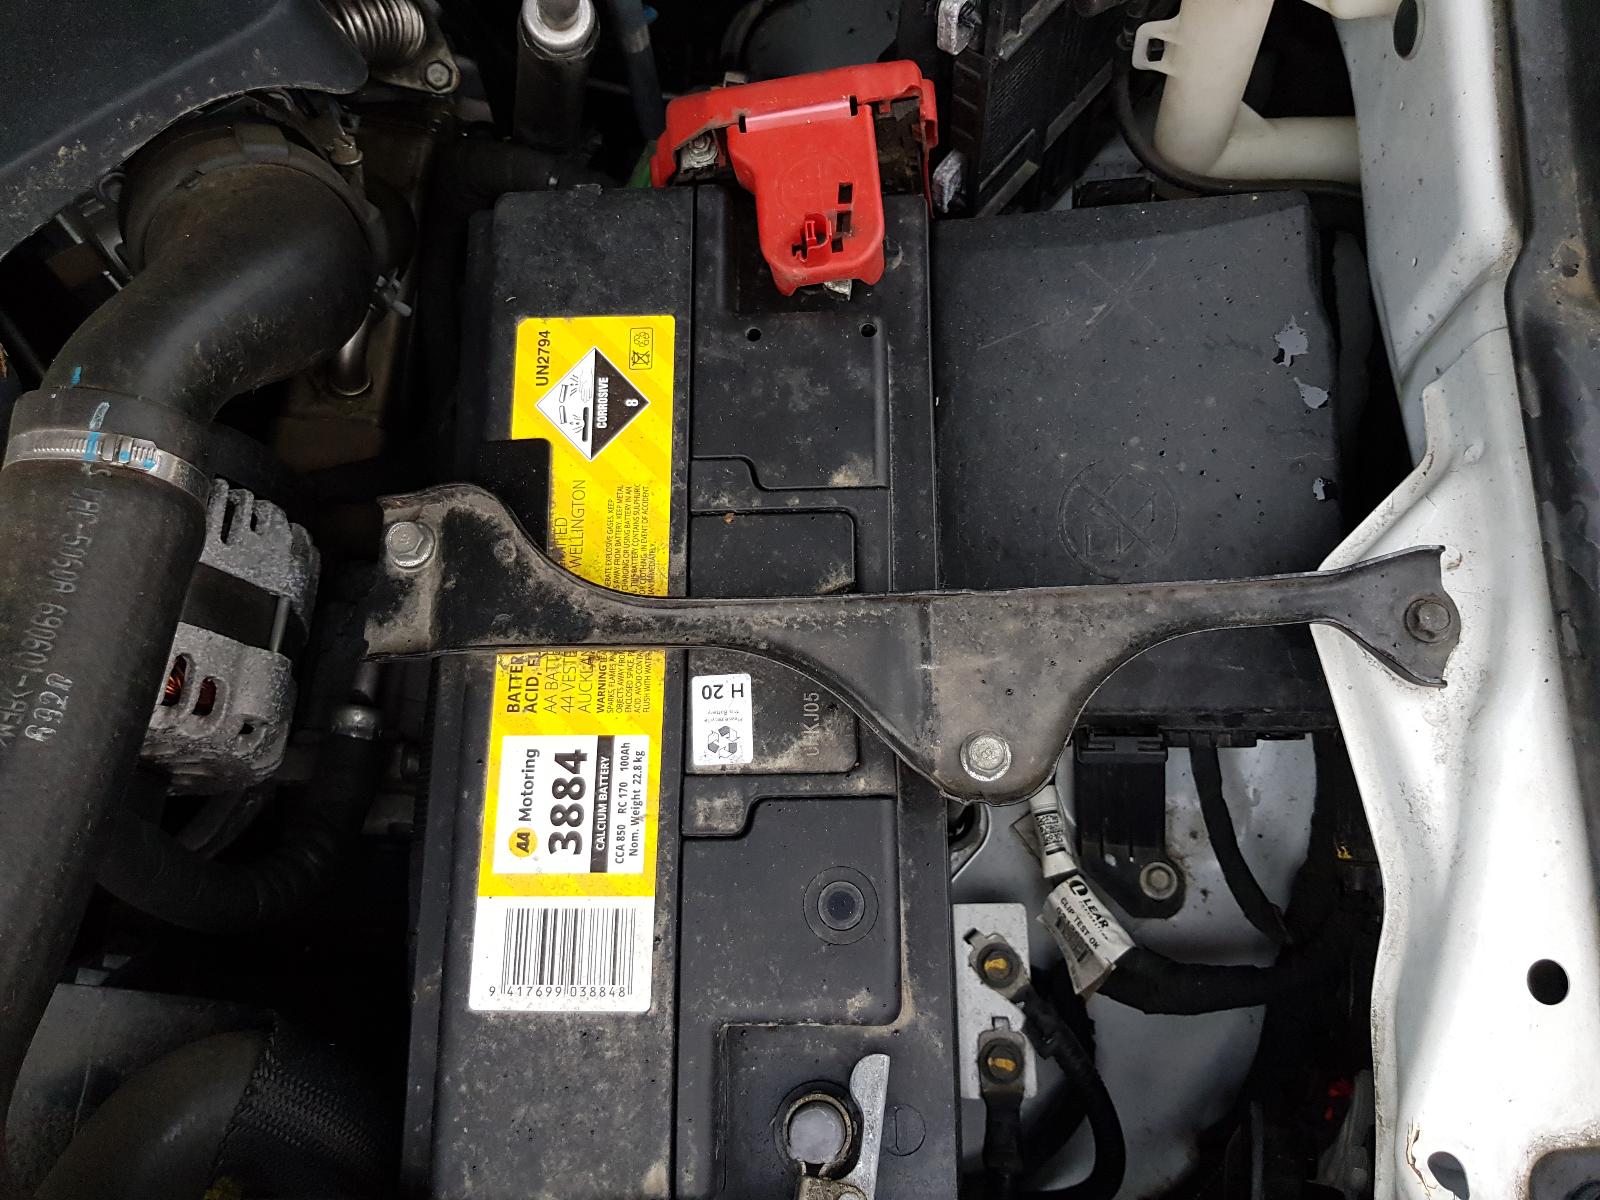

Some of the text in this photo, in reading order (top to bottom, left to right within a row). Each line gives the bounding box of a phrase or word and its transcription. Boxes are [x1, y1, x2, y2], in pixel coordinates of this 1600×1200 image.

[536, 330, 550, 386] UN2794
[597, 377, 608, 428] CORROSIVE
[642, 516, 648, 524] OF
[623, 550, 629, 558] OR
[569, 480, 594, 713] AUCKLAN WELLINGTON
[639, 586, 646, 594] OR
[625, 681, 633, 713] ENCLOSED
[632, 517, 640, 546] CONTAINS
[507, 656, 525, 713] BATTER
[524, 673, 541, 713] ACID,
[561, 651, 577, 713] 44 VESTE
[597, 665, 607, 713] WARNING
[608, 664, 616, 687] FLAMES
[617, 667, 625, 686] AWAY
[701, 683, 744, 700] H 20
[543, 695, 557, 714] AA
[607, 689, 615, 713] SPARKS,
[616, 688, 624, 713] OBJECTS
[643, 693, 651, 712] FLUSH
[517, 749, 540, 853] AA Motoring
[548, 749, 588, 855] 3884
[596, 756, 610, 851] CALCIUM BATTERY
[615, 742, 630, 864] CCA 850 RC 170 100Ah
[629, 751, 645, 856] Nom. Weight 22.8 kg
[1061, 897, 1100, 949] CLIP TEST OK
[1083, 899, 1109, 927] LEAR
[489, 986, 625, 997] 9 417699 038848
